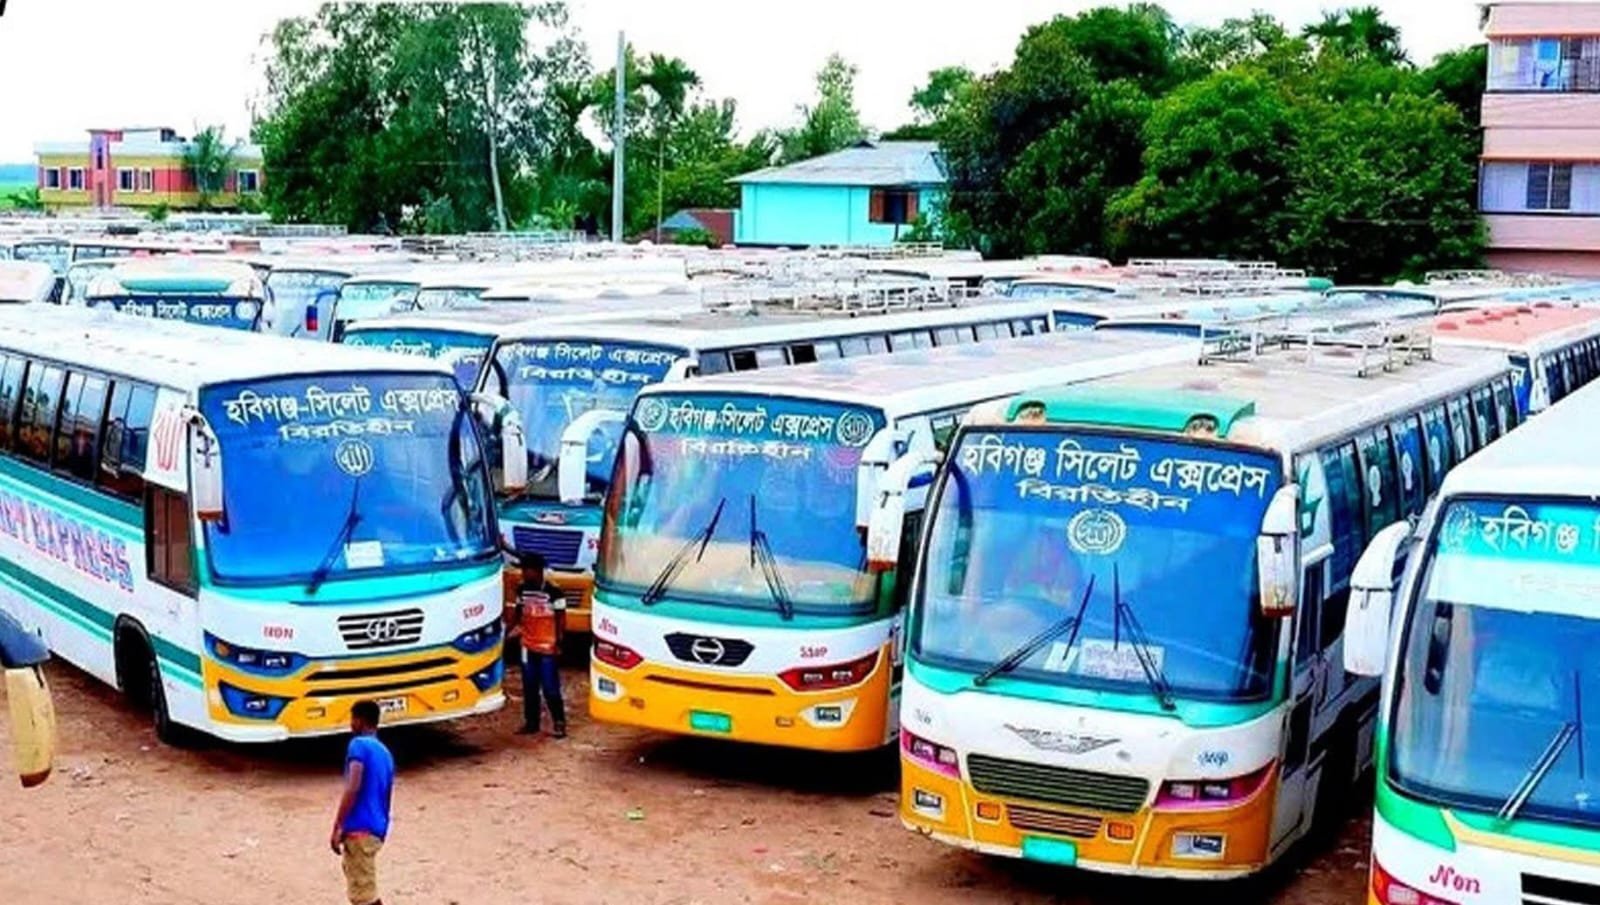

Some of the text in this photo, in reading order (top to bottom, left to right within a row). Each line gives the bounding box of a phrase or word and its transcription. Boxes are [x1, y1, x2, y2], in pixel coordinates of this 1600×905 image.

[962, 434, 1271, 500] হবিগঞ্জ সিলেট এক্সপ্রেস
[1015, 478, 1192, 513] বিরতিহীন
[1479, 504, 1580, 555] হবিগঞ্জ
[1429, 864, 1481, 894] Non
